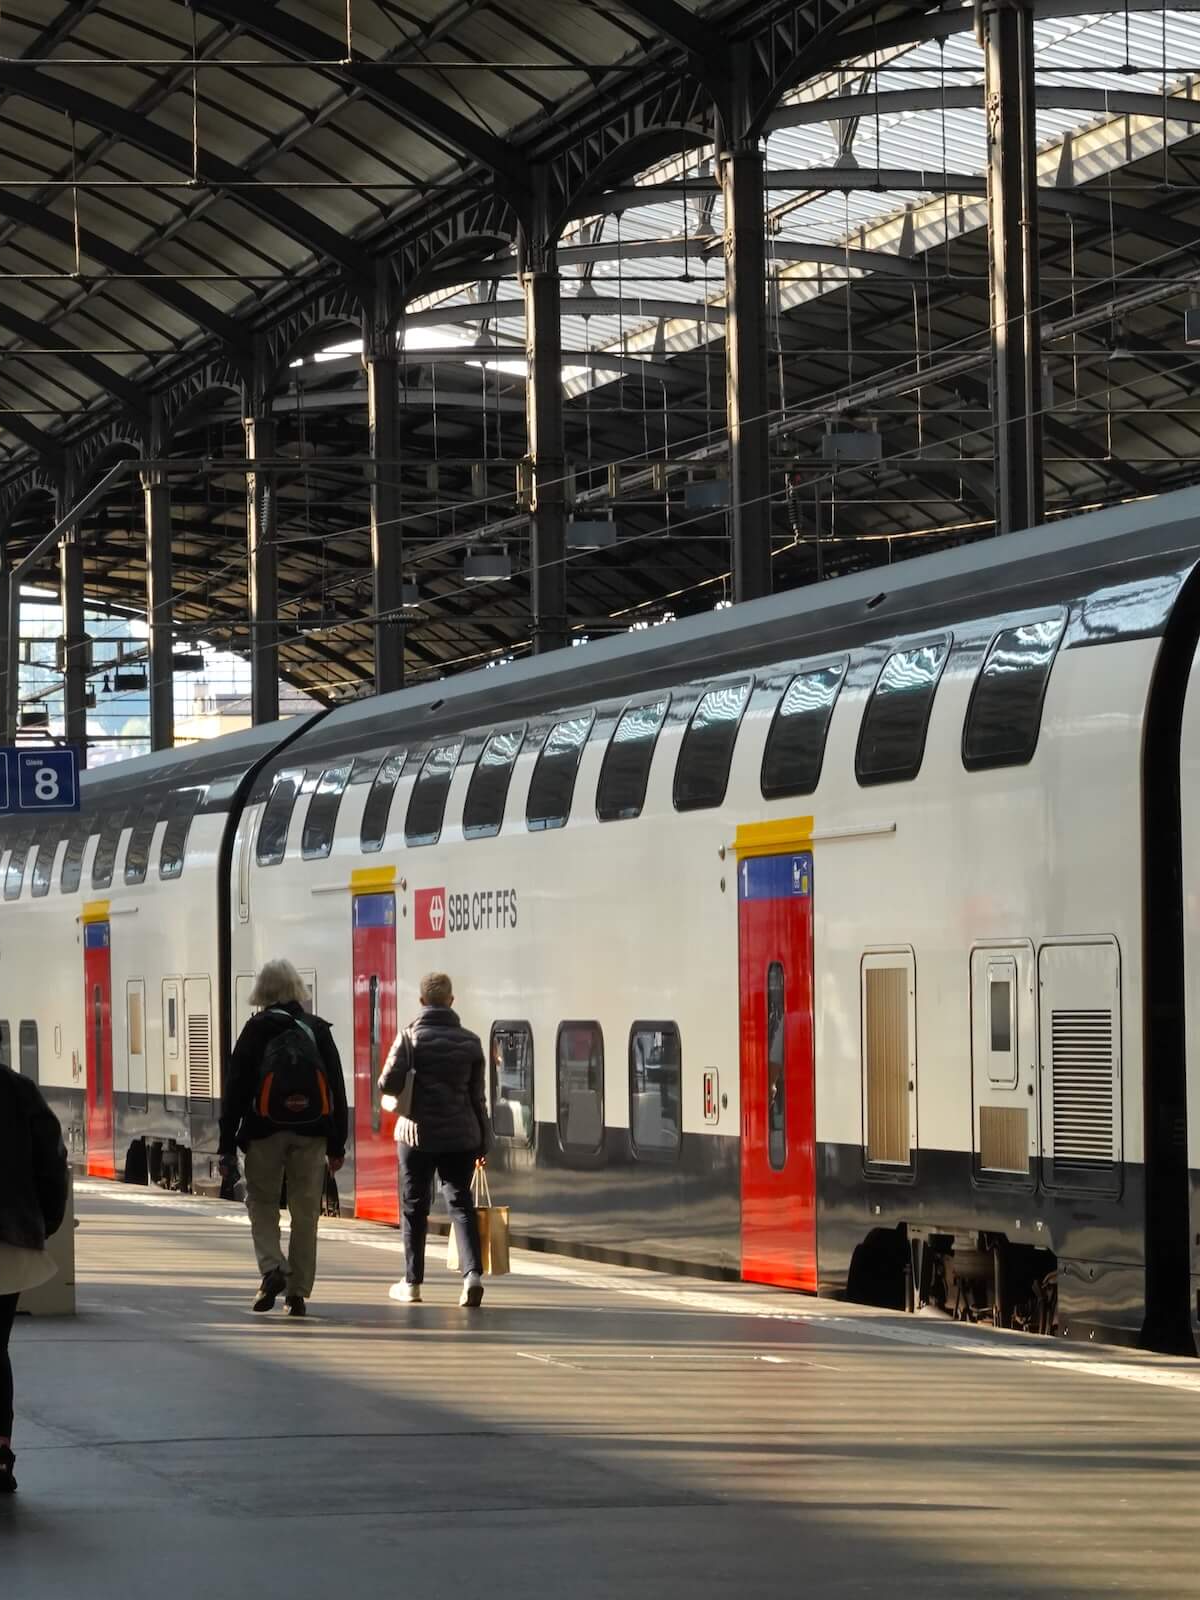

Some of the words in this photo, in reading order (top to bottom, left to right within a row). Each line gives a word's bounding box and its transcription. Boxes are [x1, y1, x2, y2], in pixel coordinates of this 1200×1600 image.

[35, 768, 59, 800] 8
[742, 861, 748, 897] 1
[448, 894, 470, 932] SBB
[472, 891, 493, 930] CFF
[496, 888, 517, 928] FFS
